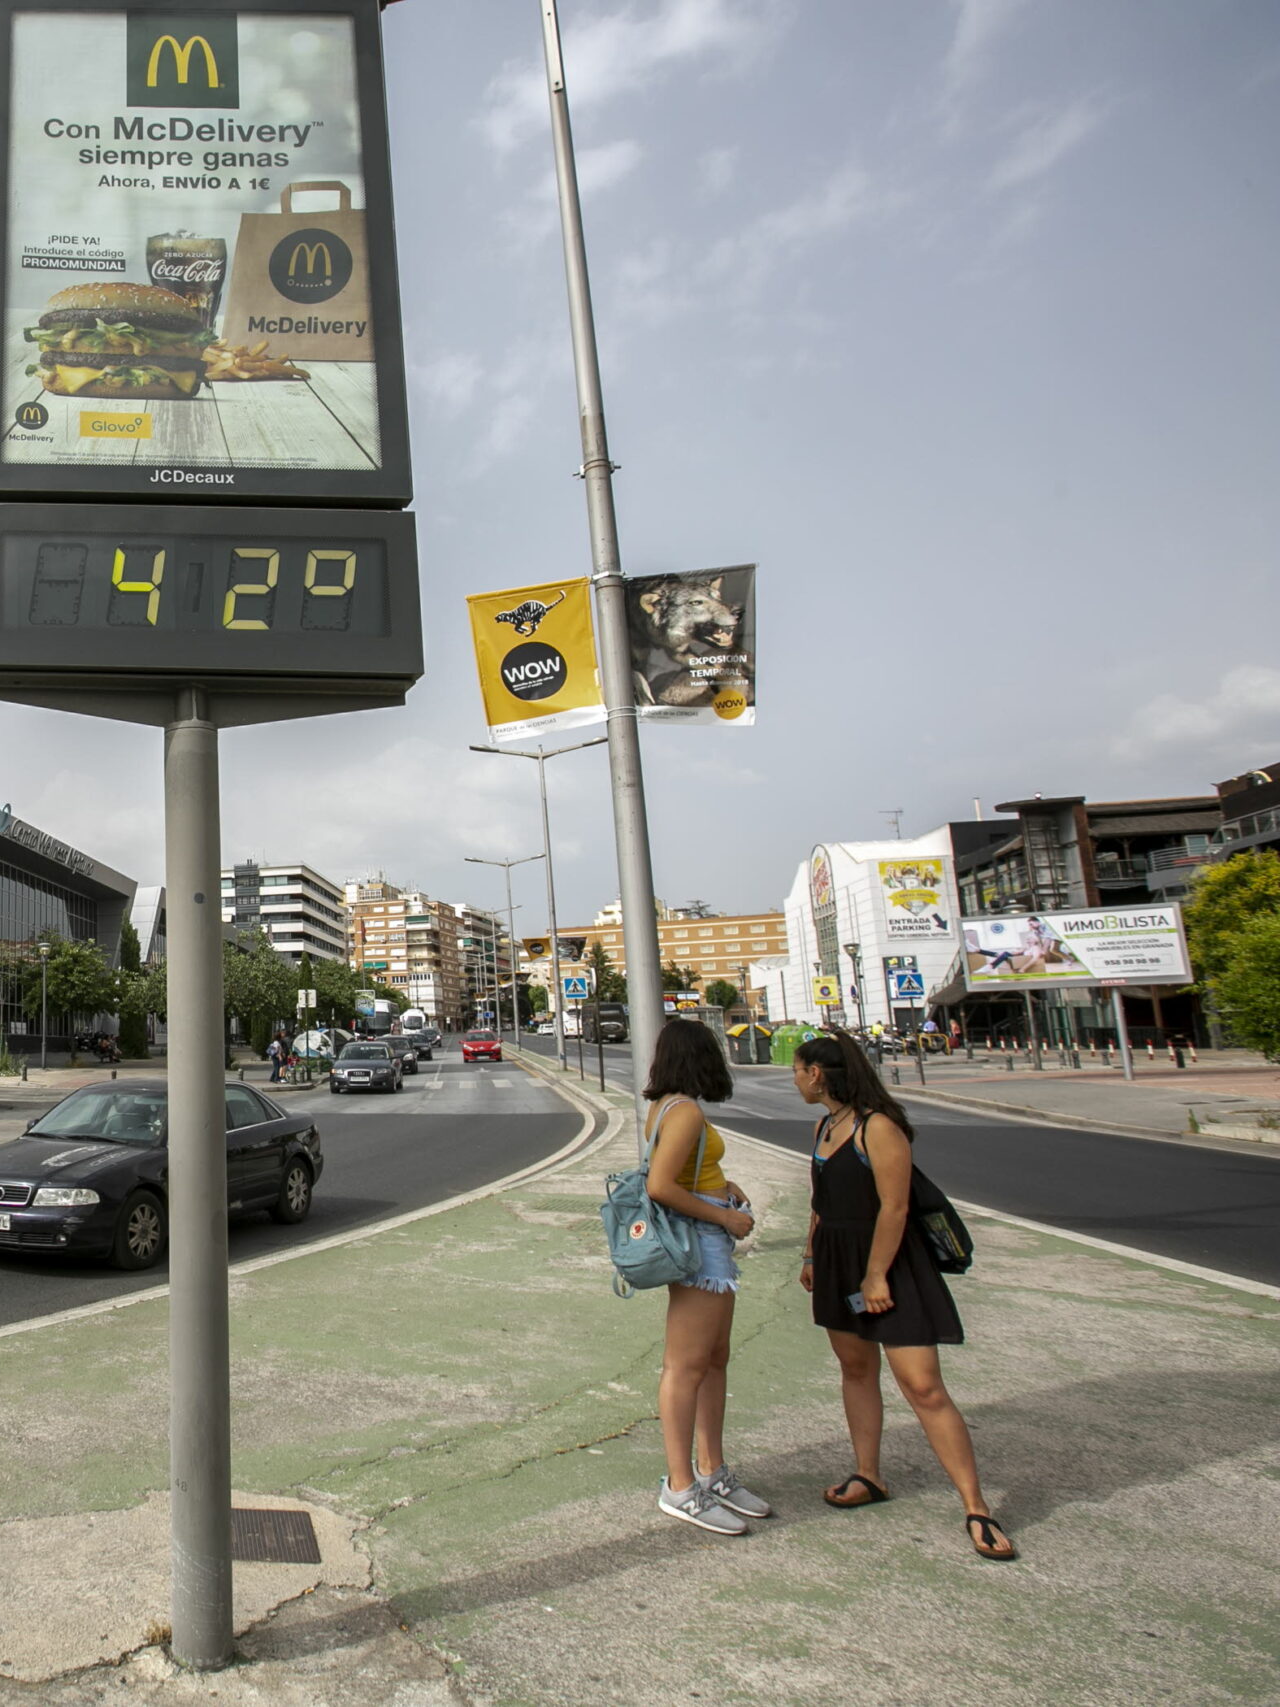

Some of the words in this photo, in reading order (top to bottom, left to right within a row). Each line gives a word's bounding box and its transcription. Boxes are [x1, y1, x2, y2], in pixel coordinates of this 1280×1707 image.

[43, 118, 101, 140] Con
[78, 145, 193, 168] siempre
[203, 150, 290, 170] ganas
[98, 174, 156, 191] Ahora,
[162, 172, 221, 190] ENVÍO
[228, 177, 241, 190] A
[249, 177, 270, 191] 1€
[83, 236, 101, 246] YA!
[23, 245, 74, 256] Introduce
[76, 248, 86, 257] el
[88, 248, 124, 259] código
[22, 257, 125, 271] PROMOMUNDIAL
[247, 316, 368, 337] McDelivery
[91, 418, 136, 433] Glovo
[8, 433, 54, 443] McDelivery
[150, 469, 235, 485] JCDecaux
[689, 654, 747, 666] EXPOSICIÓN
[504, 656, 560, 683] WOW
[690, 668, 741, 678] TEMPORAL
[715, 699, 743, 710] WOW
[888, 917, 932, 925] ENTRADA
[891, 924, 932, 932] PARKING
[1064, 914, 1170, 932] INMOBILISTA
